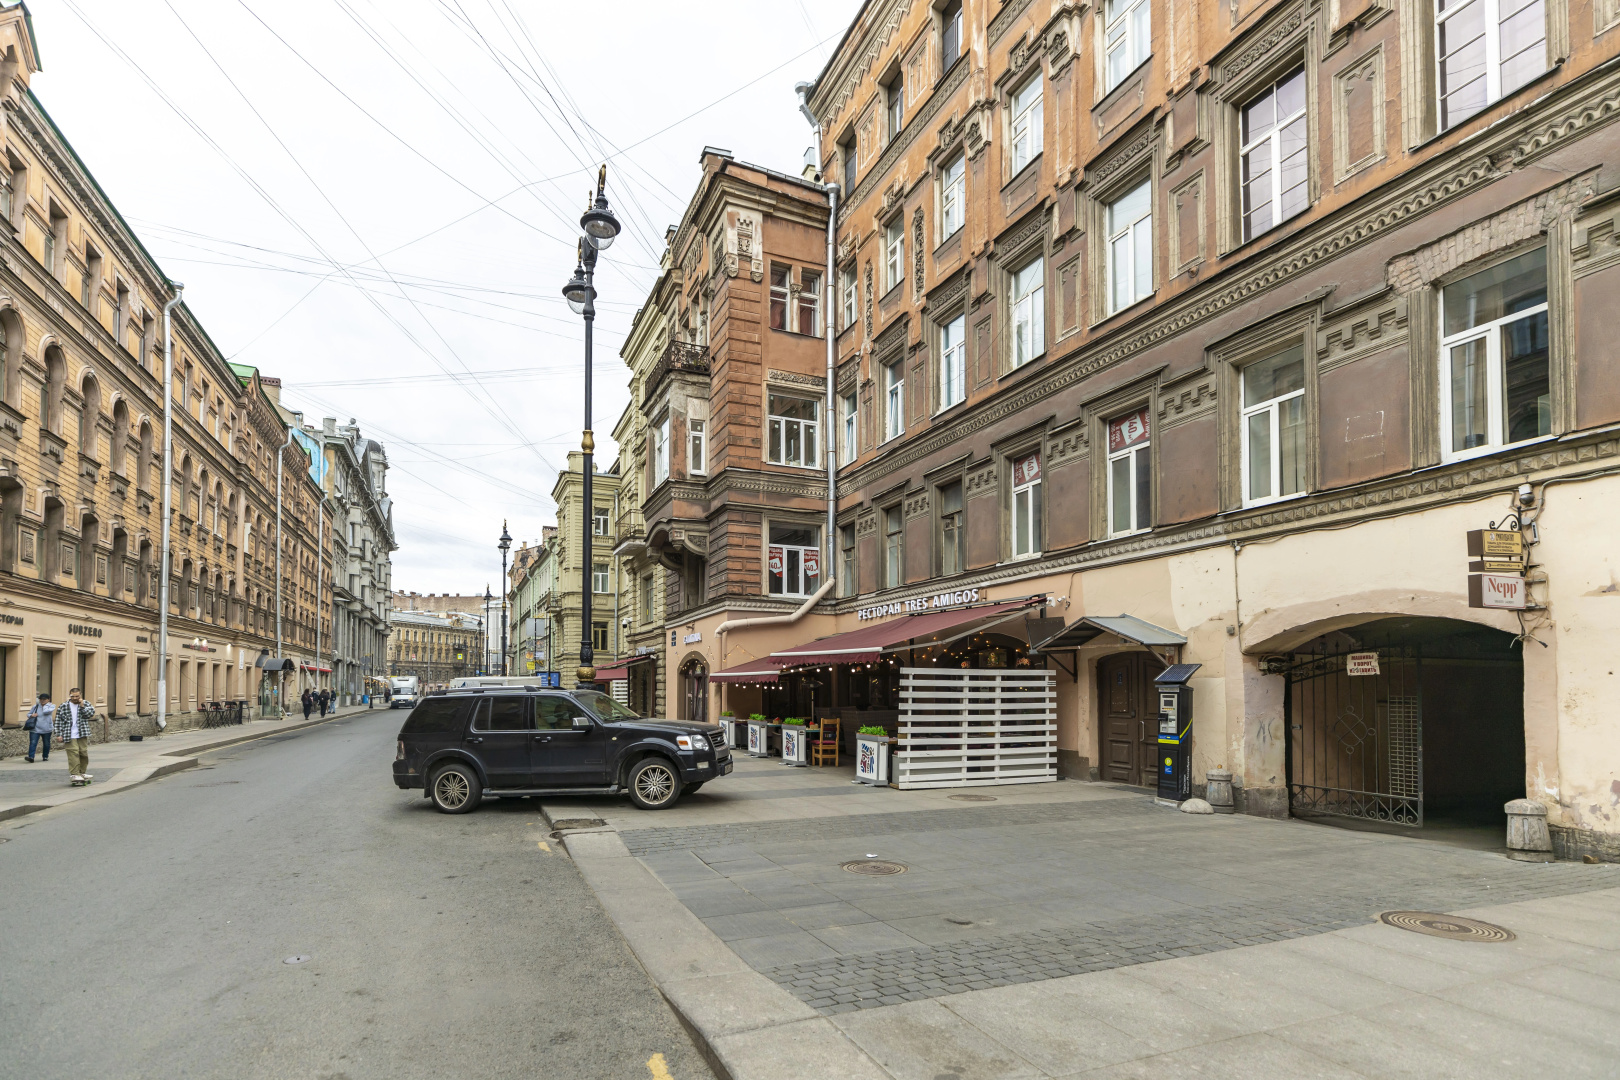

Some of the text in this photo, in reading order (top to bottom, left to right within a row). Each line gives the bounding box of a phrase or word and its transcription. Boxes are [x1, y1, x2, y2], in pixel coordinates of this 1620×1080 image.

[1128, 415, 1138, 434] 140
[1488, 577, 1517, 599] Nepp
[858, 588, 979, 620] РЕСТОРАН TRES AMIGOS
[68, 623, 103, 638] SUBZERO
